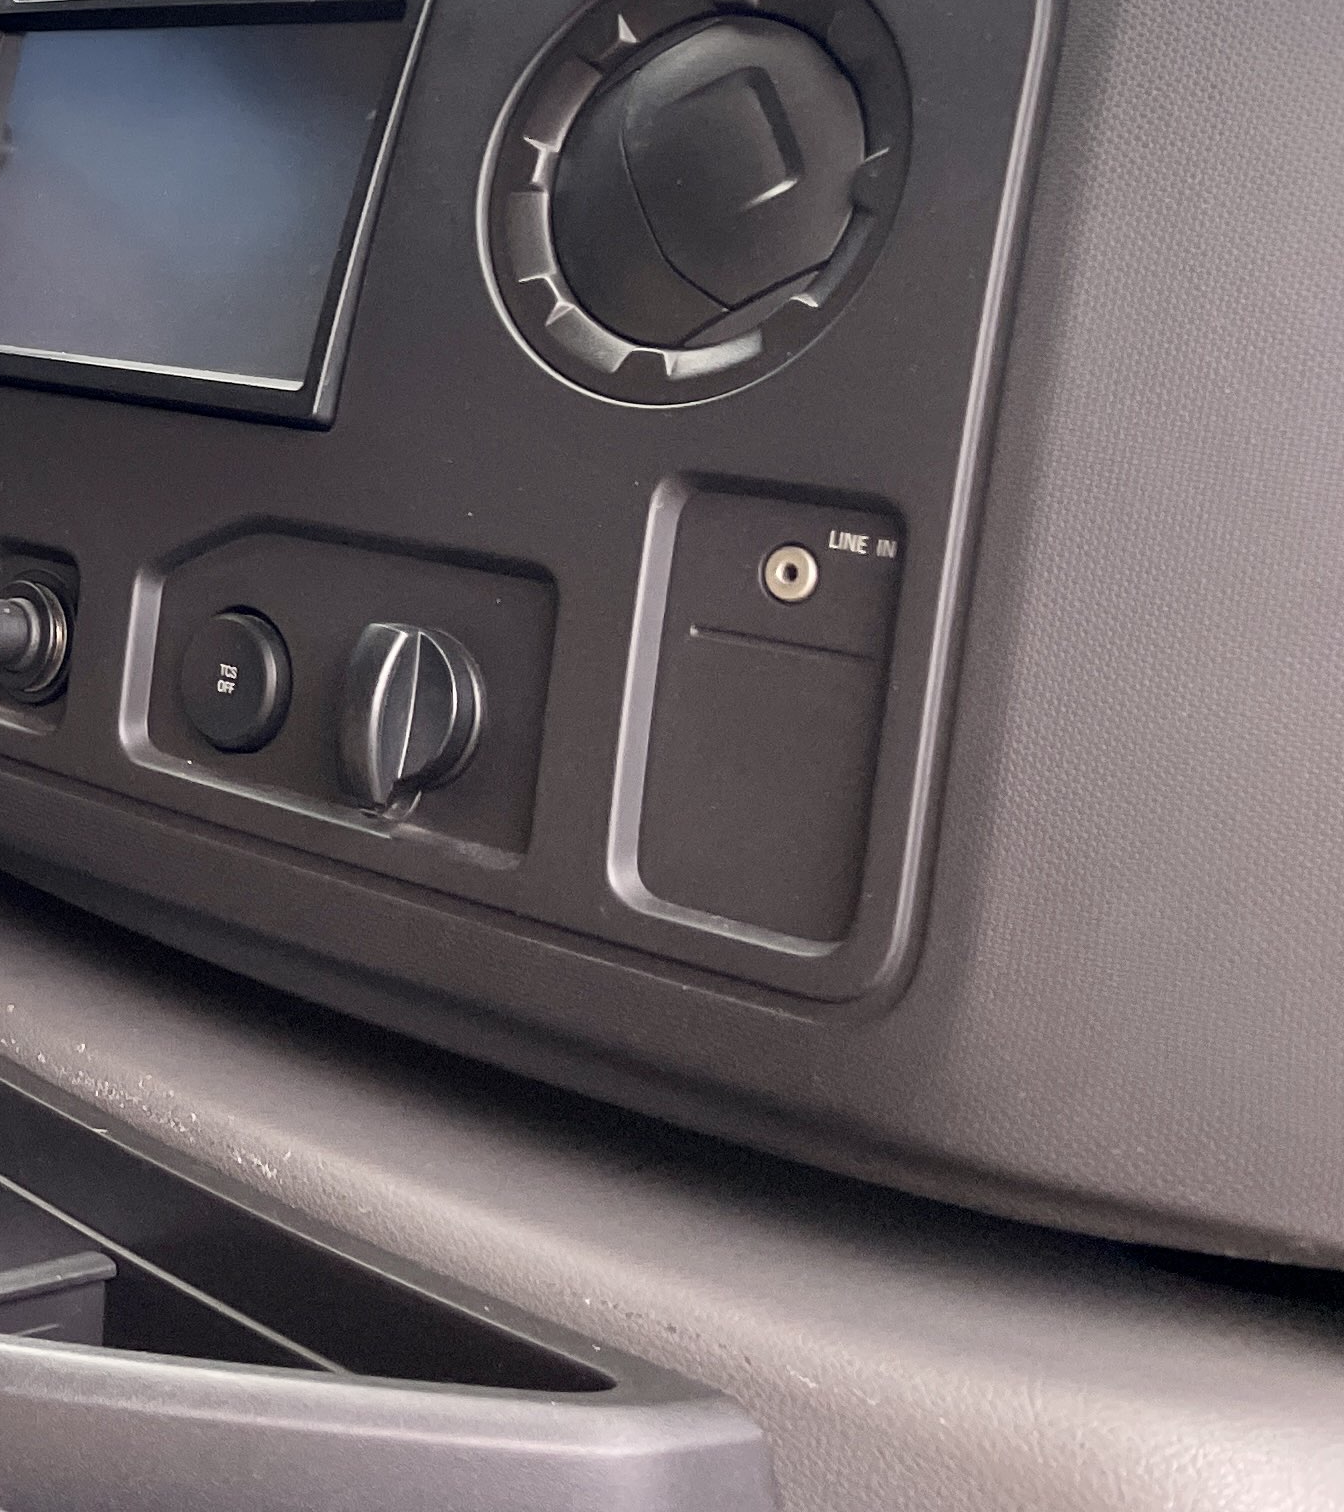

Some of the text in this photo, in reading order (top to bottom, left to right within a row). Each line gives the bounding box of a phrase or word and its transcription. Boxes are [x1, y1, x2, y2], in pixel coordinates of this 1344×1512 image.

[829, 530, 898, 559] LINE IN
[220, 663, 238, 680] TCS
[217, 679, 236, 694] OFF
